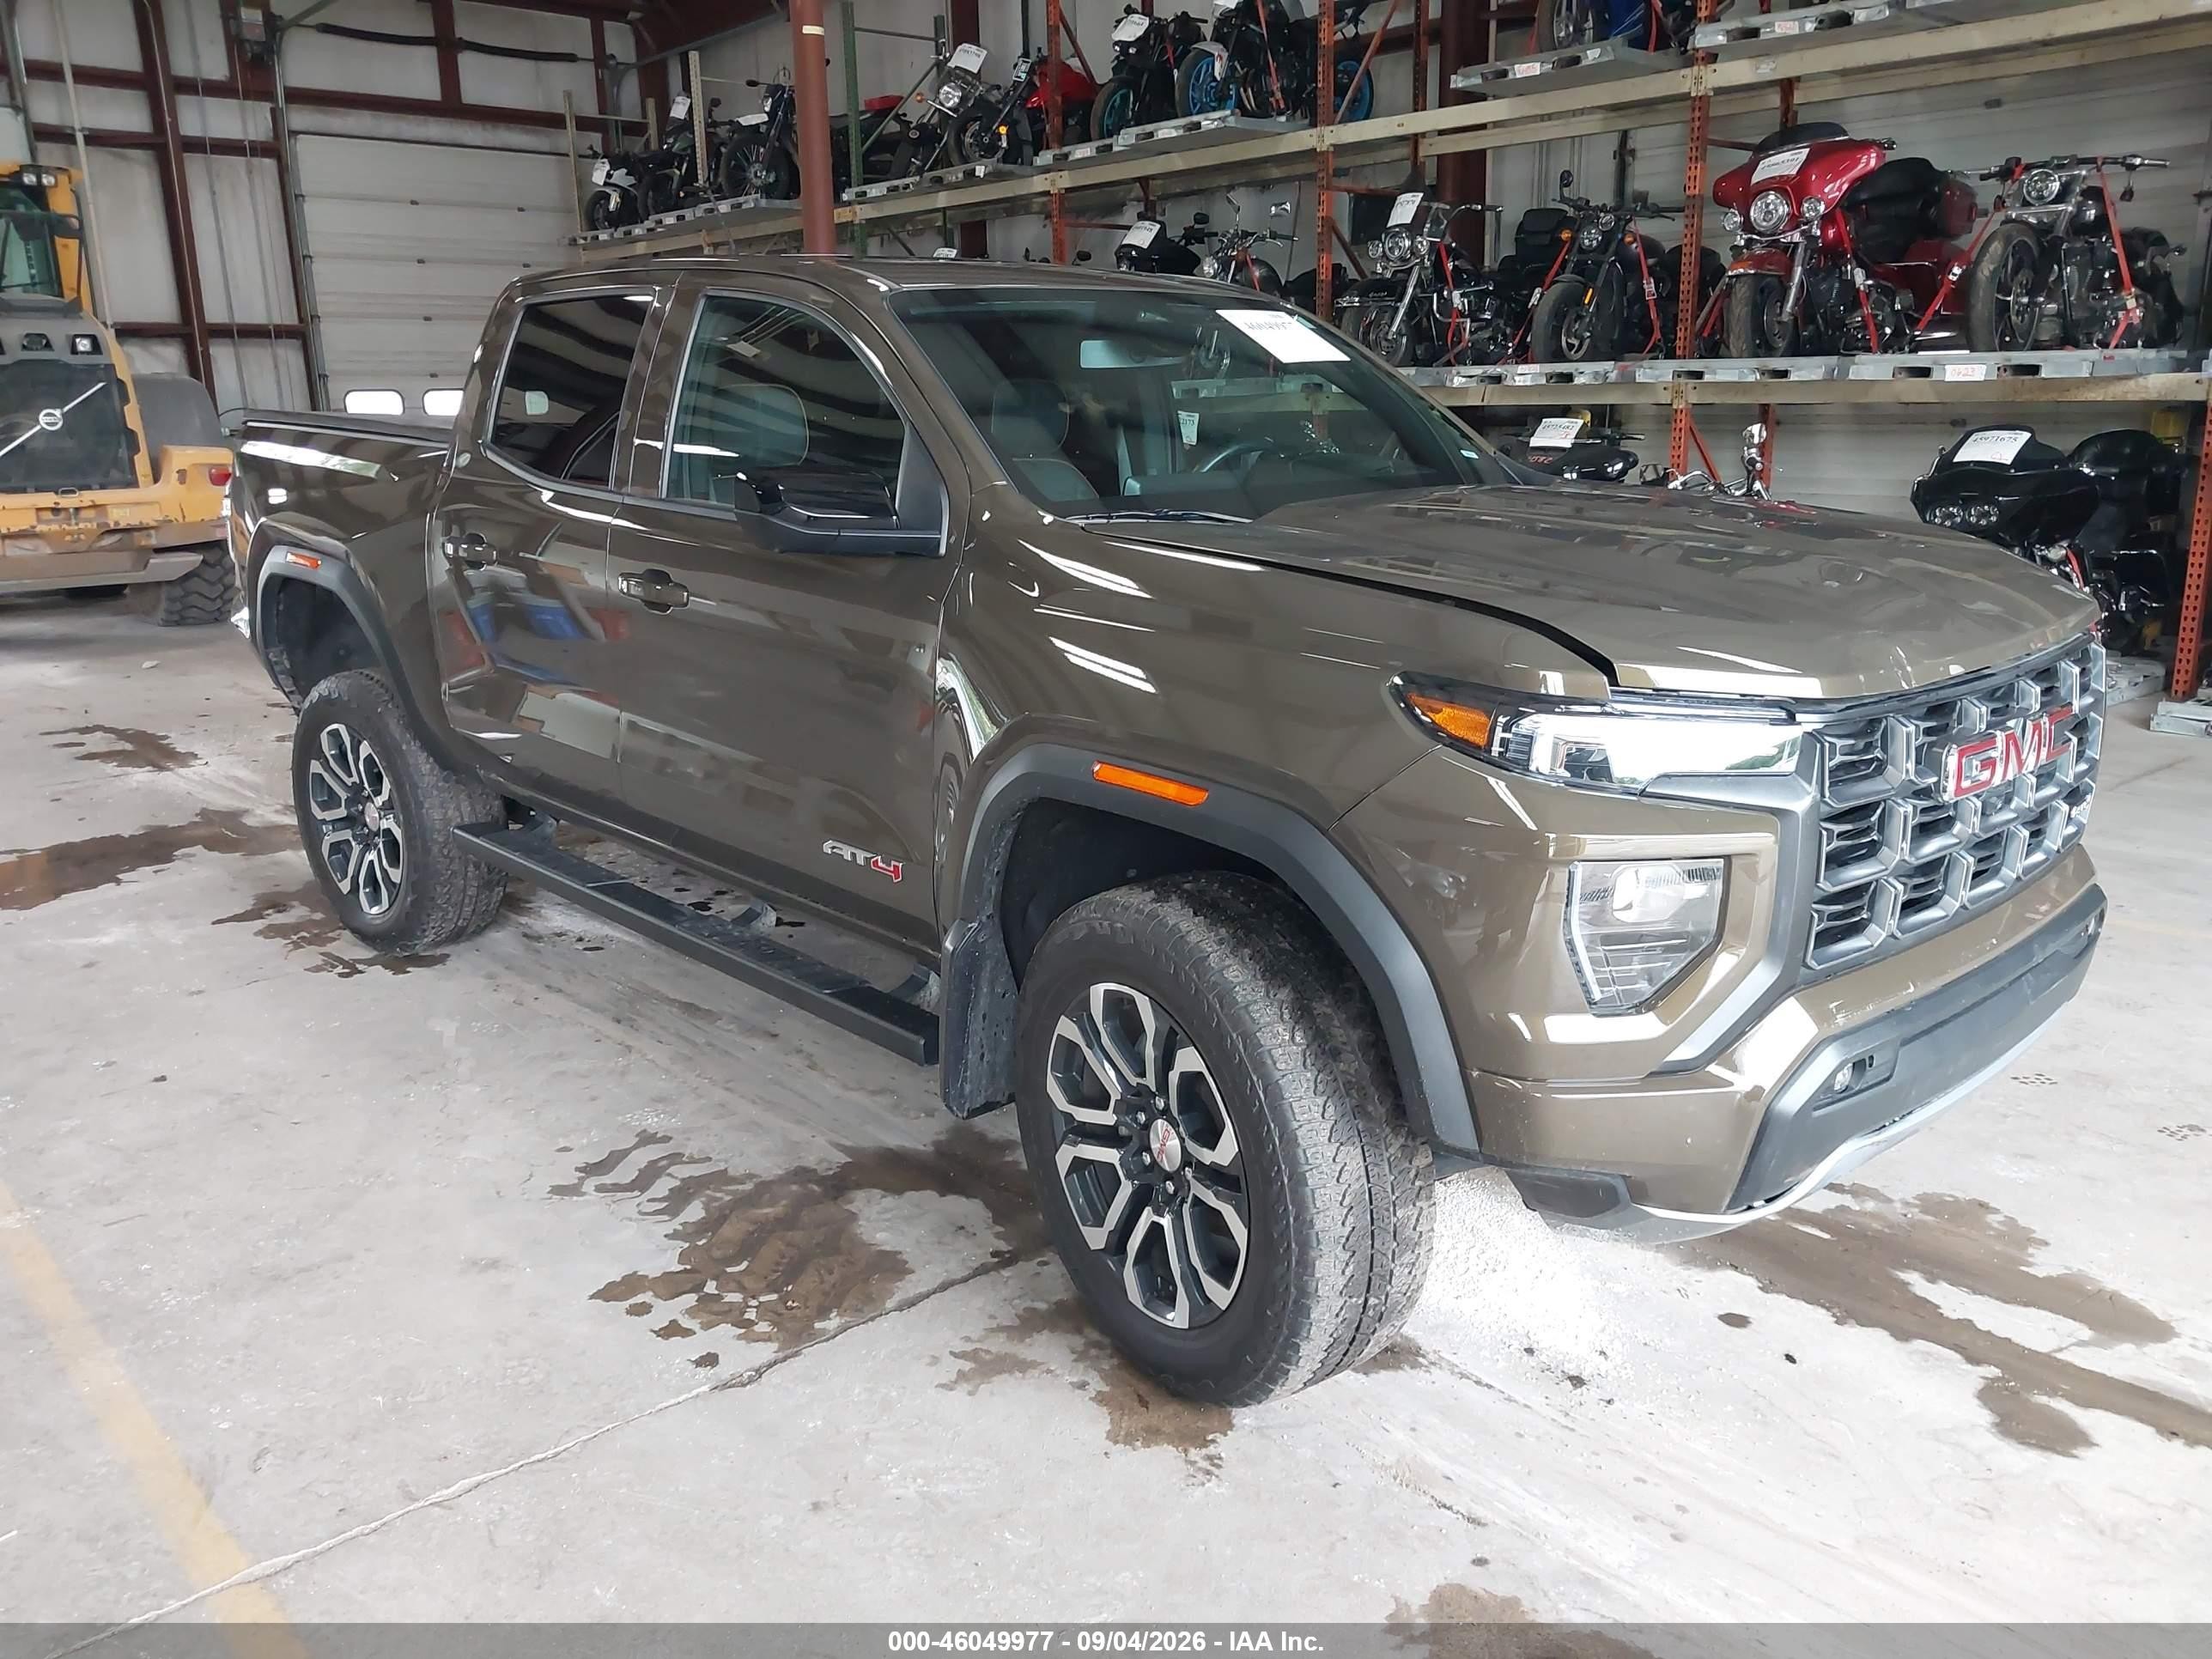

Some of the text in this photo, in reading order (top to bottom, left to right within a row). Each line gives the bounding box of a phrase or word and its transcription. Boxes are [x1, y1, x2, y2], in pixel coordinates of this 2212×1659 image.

[1950, 703, 2075, 799] GMC
[823, 840, 903, 883] AT4
[1157, 1127, 1171, 1163] GMC
